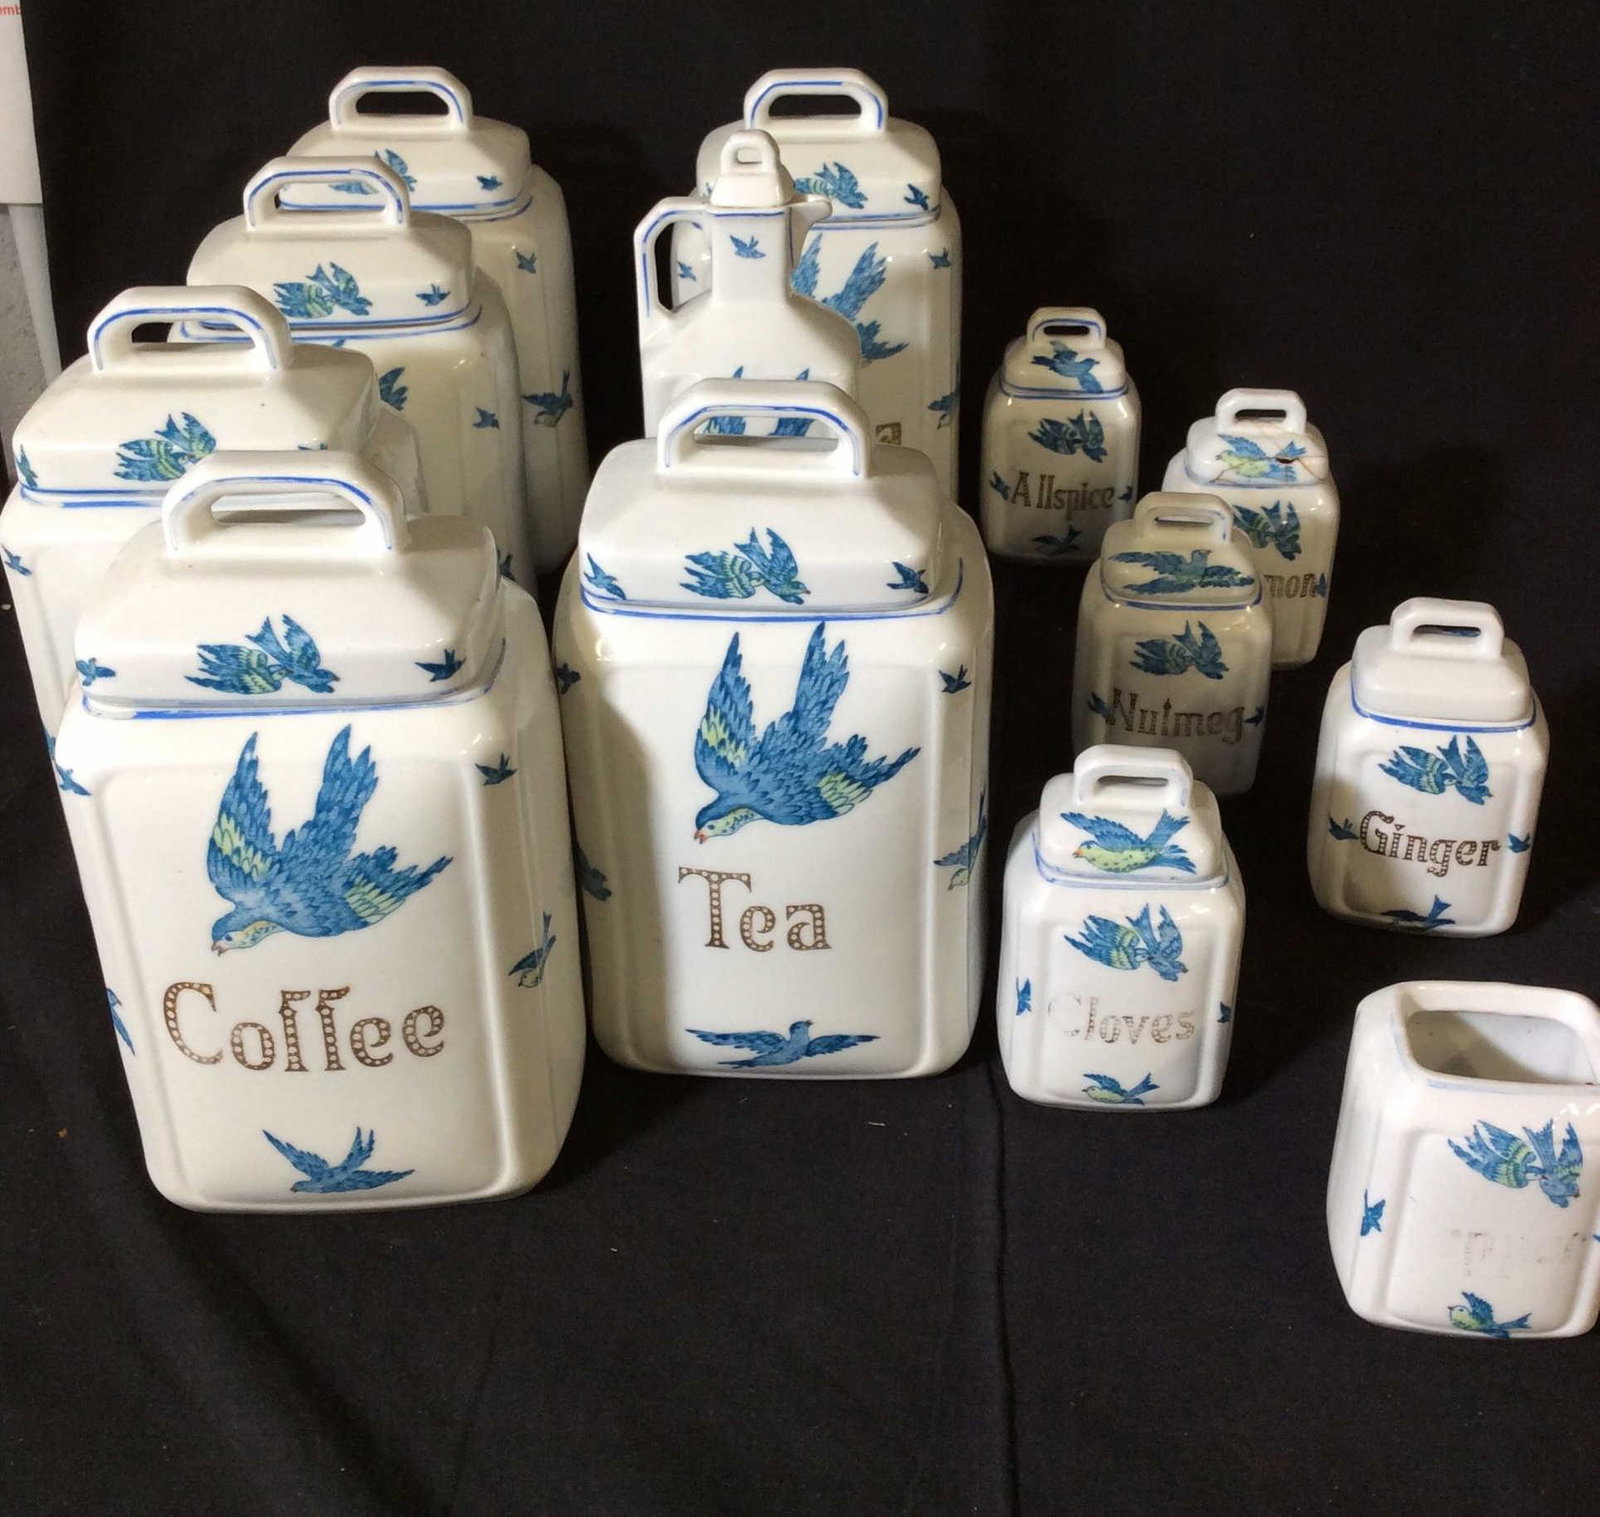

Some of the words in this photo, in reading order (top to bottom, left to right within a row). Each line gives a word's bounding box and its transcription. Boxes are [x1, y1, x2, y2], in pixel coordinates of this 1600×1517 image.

[1008, 471, 1116, 521] Allspice
[1105, 688, 1246, 746] Nutmeg
[1360, 810, 1501, 877] Ginger
[678, 866, 832, 952] Tea
[164, 981, 445, 1072] Coffee
